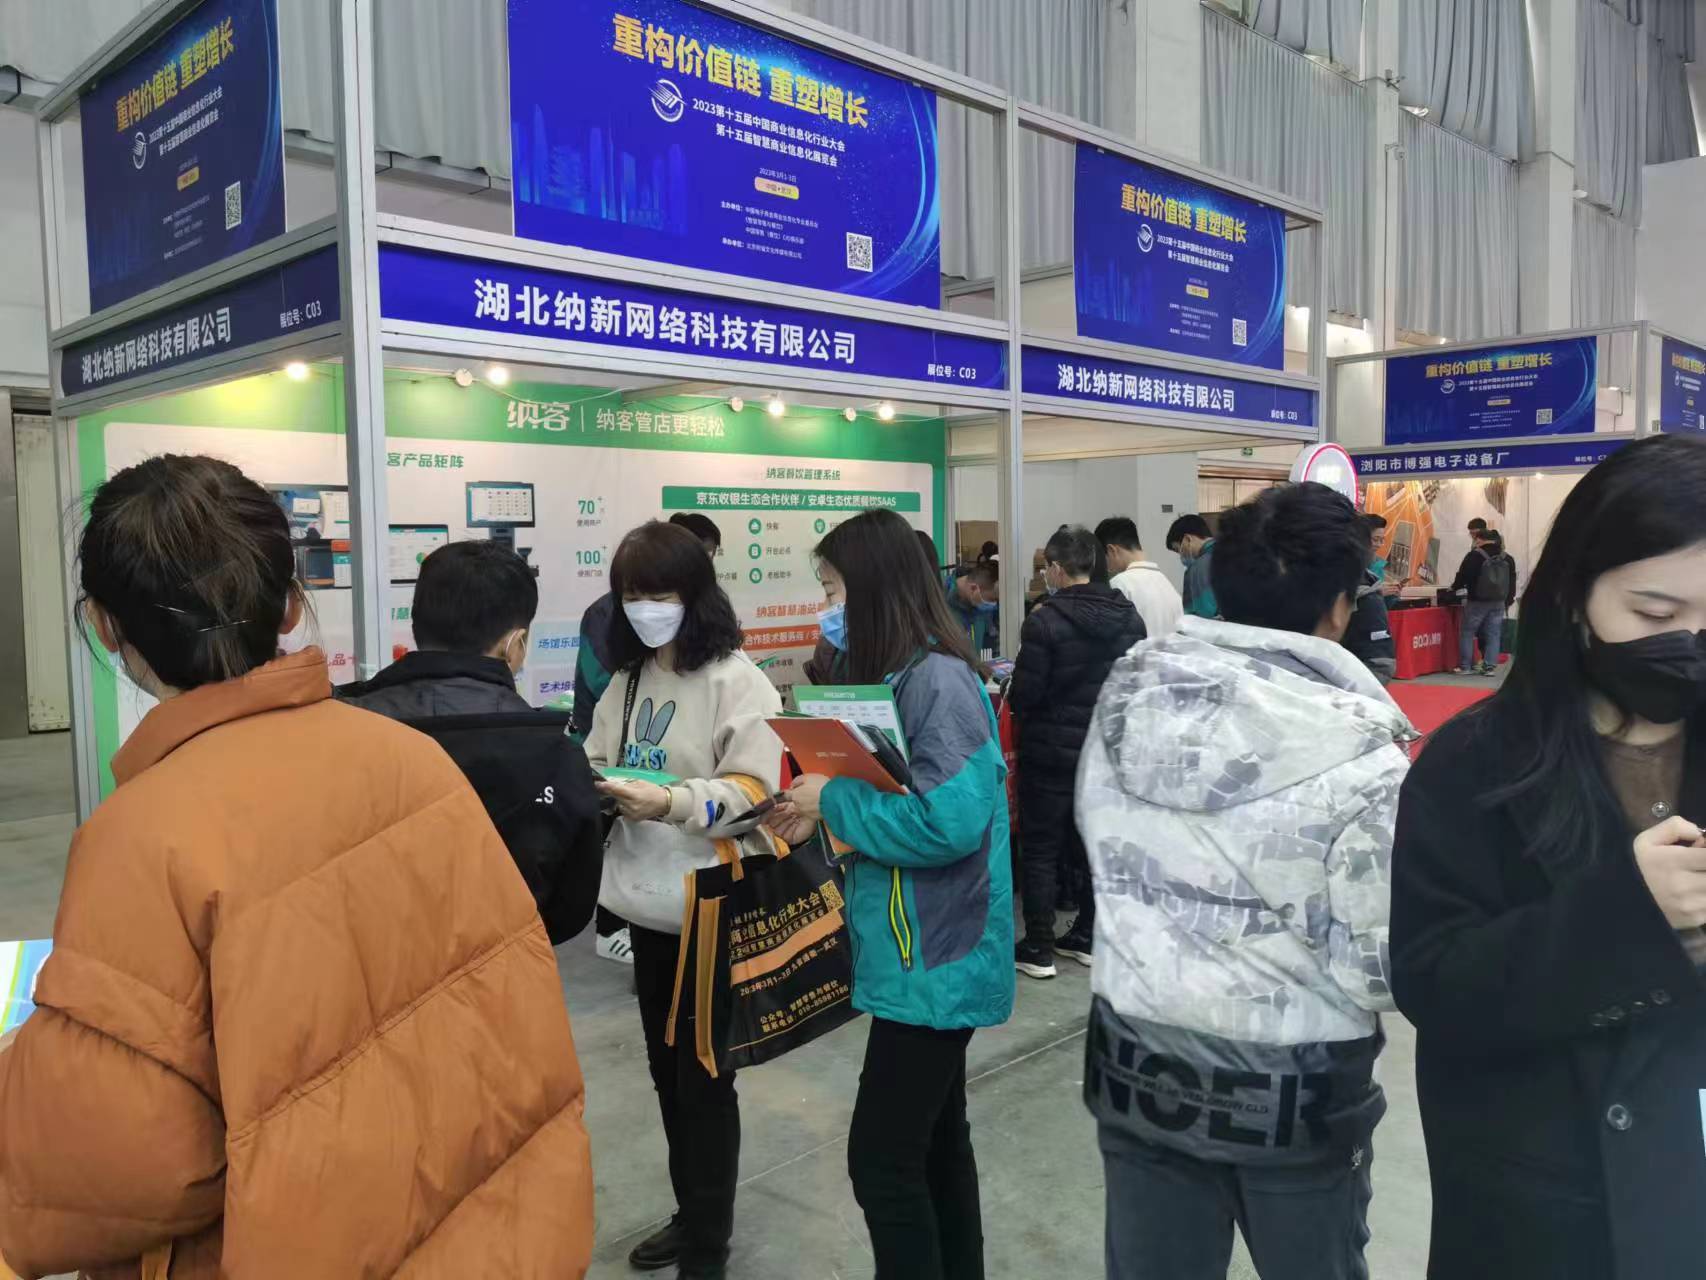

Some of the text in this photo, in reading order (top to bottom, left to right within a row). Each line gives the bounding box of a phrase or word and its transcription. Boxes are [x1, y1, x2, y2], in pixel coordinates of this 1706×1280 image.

[117, 16, 234, 132] 重构价值链 重塑增长
[613, 13, 868, 128] 重构价值链 重塑增长
[693, 98, 845, 152] 2023第十五届中国商业信息化行业大会
[716, 123, 838, 167] 第十五届智慧商业信息化展览会
[1121, 183, 1248, 244] 重构价值链 重塑增长
[474, 278, 857, 364] 湖北纳新网络科技有限公司
[82, 307, 231, 385] 湖北纳新网络科技有限公司
[1425, 353, 1552, 378] 重构价值链 重塑增长
[1057, 364, 1235, 412] 湖北纳新网络科技有限公司
[507, 400, 725, 437] 纳客 纳客管店更轻松
[766, 467, 841, 480] 纳客餐饮管理系统
[1360, 451, 1510, 472] 浏阳市博强电子设备厂
[696, 492, 800, 507] 京东收银生态合作伙伴
